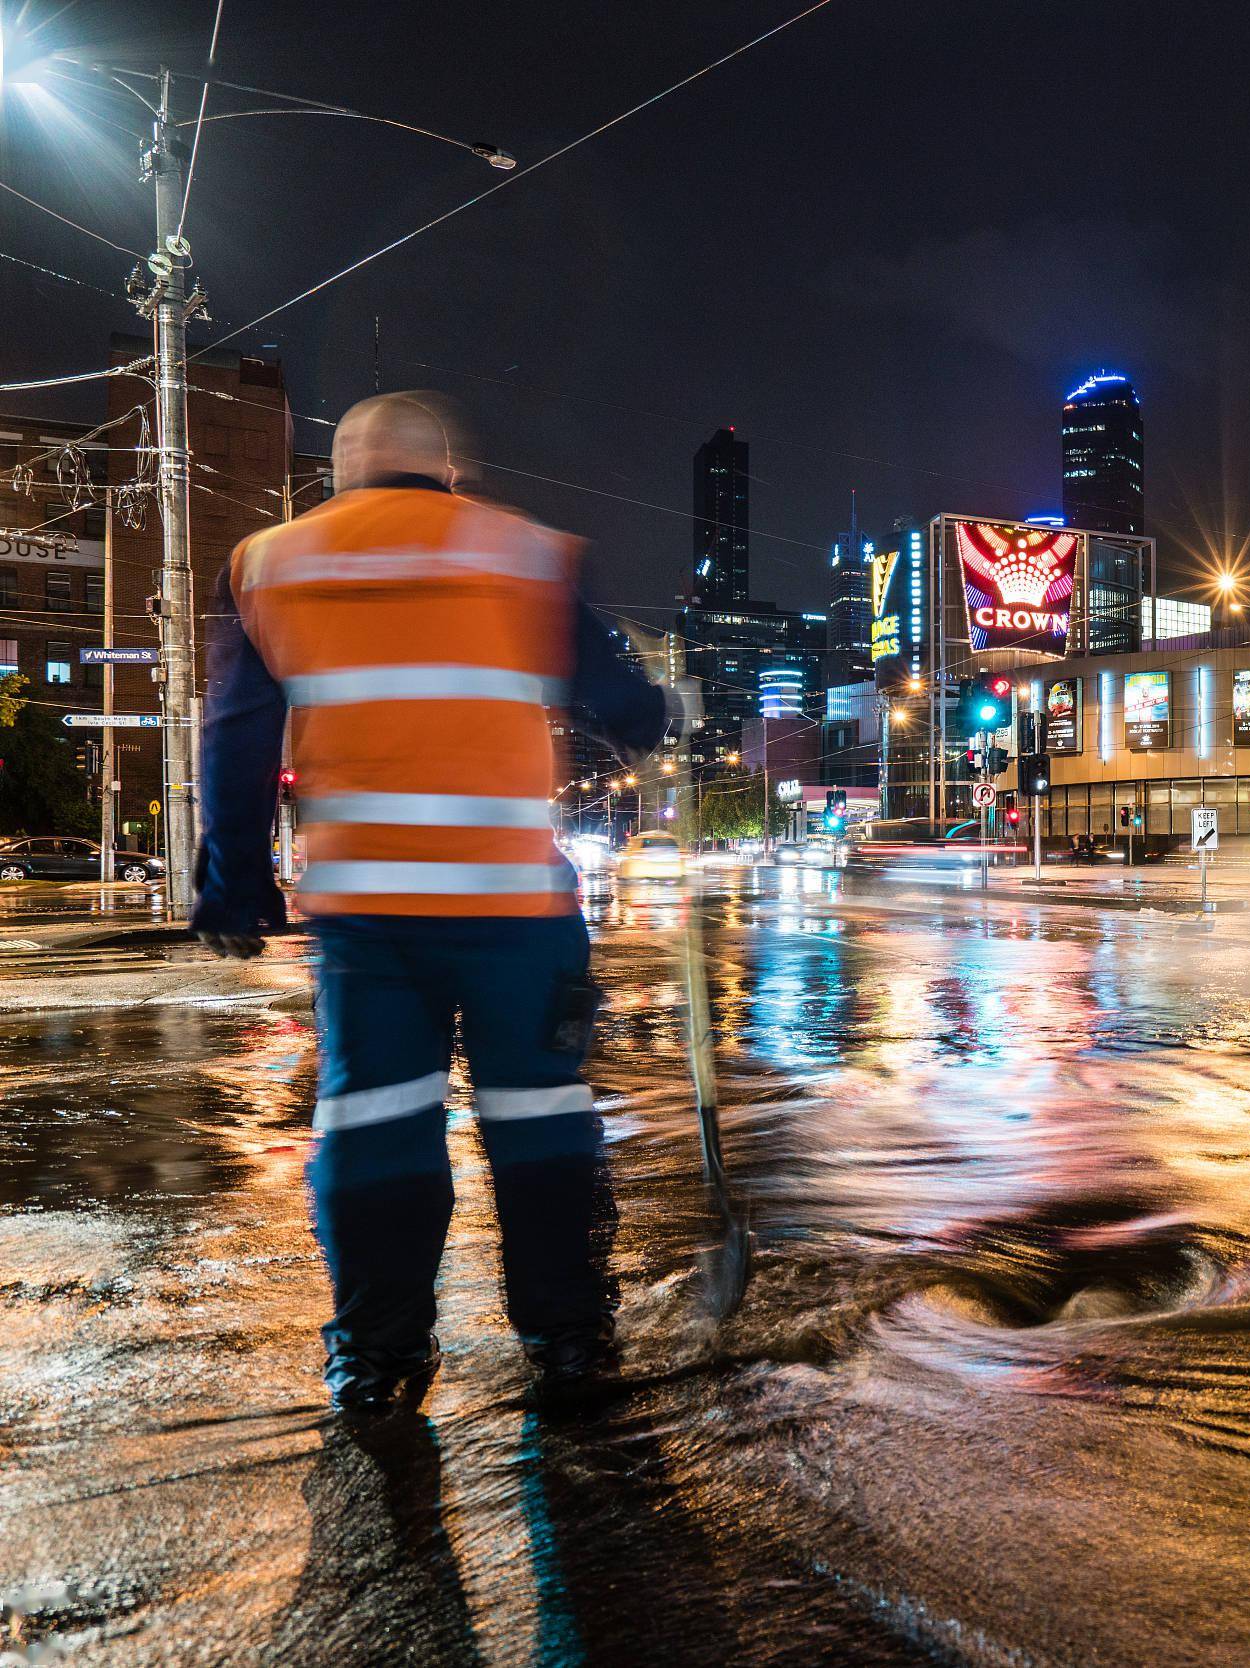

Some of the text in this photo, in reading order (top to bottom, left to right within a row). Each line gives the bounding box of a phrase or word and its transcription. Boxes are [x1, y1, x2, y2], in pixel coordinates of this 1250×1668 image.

[975, 607, 1068, 632] CROWN
[93, 651, 152, 659] Whiteman St
[1198, 820, 1214, 828] LEFT
